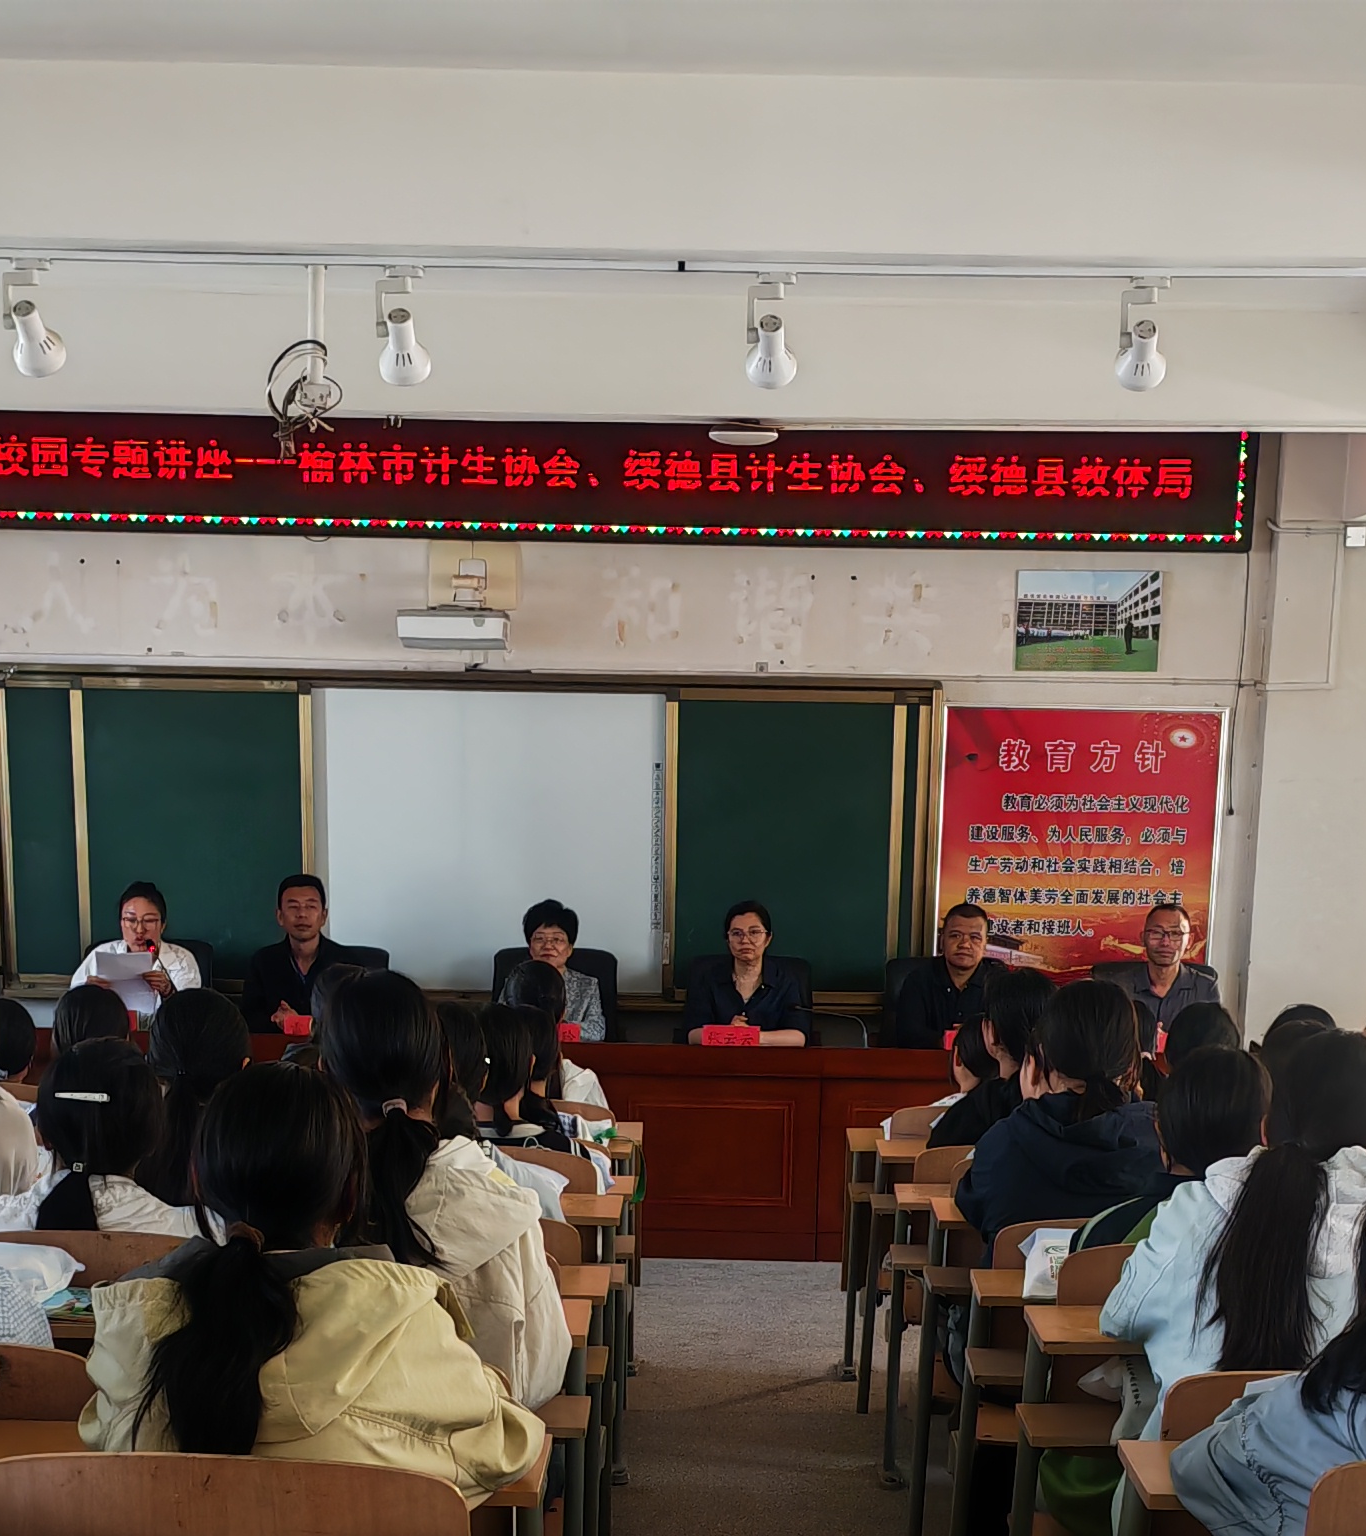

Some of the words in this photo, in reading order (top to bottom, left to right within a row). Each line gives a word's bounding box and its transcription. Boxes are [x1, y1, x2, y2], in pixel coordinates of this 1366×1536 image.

[999, 739, 1166, 773] 教育方针
[1002, 794, 1189, 814] 教育必须为社会主义现代化
[969, 825, 1187, 845] 建设服务、为人民服务，必须与
[967, 856, 1186, 876] 生产劳动和社会实践相结合，培
[966, 887, 1183, 906] 养德智体美劳全面发展的社会主
